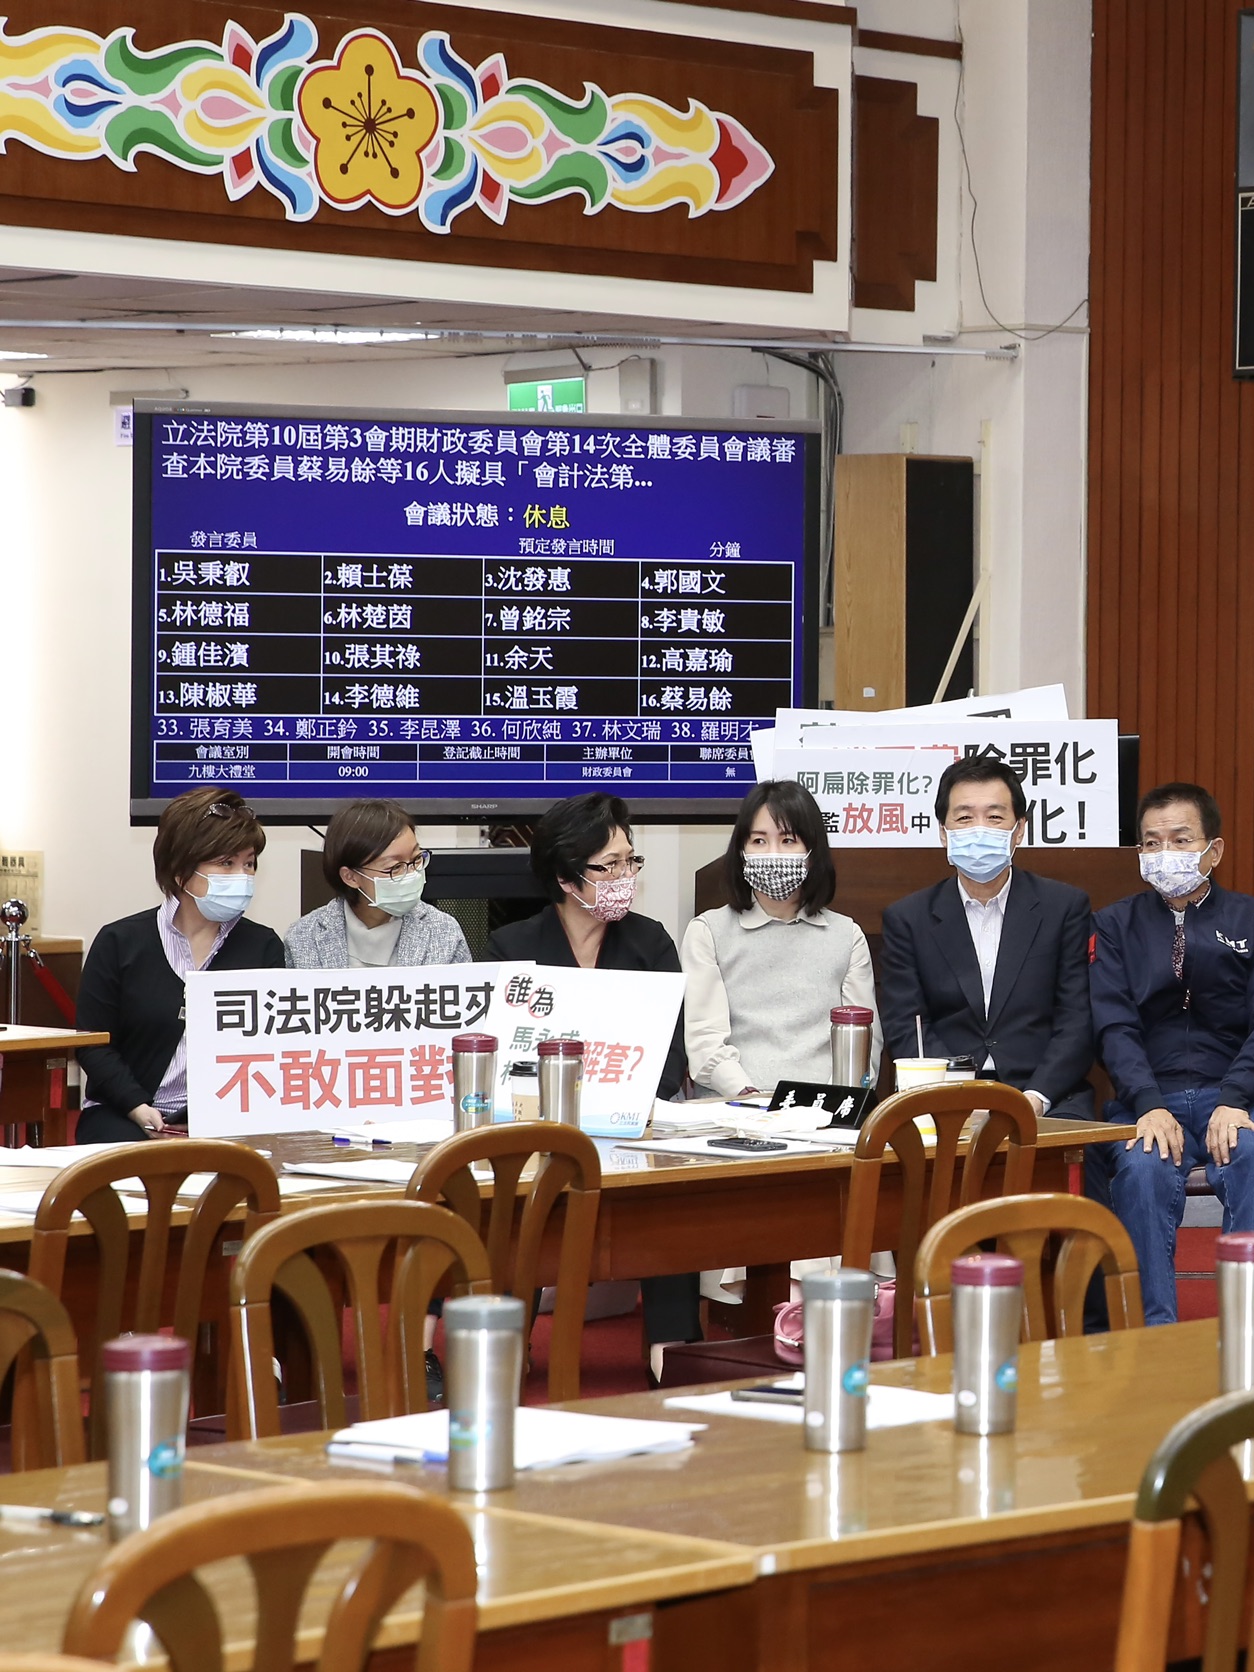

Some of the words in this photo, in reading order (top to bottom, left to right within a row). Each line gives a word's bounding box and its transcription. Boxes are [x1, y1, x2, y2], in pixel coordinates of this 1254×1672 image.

[161, 419, 796, 464] 立法院第10屆第3會期財政委員會第14次全體委員會議審
[189, 530, 258, 549] 發言委員
[518, 538, 615, 556] 預定發言時間
[709, 541, 741, 558] 分鐘
[159, 560, 251, 587] 1.吳秉叡
[324, 562, 414, 590] 2.賴士葆
[484, 565, 572, 592] 3.沈發惠
[641, 568, 726, 594] 4.郭國文
[158, 600, 250, 628] 5.林德福
[323, 602, 413, 630] 6.林楚茵
[484, 605, 571, 632] 7.曾銘宗
[640, 607, 726, 633] 8.李貴敏
[324, 643, 421, 670] 10.張其祿
[485, 644, 554, 671] 11.余天
[641, 646, 733, 673] 12.高嘉瑜
[158, 681, 258, 708] 13.陳椒華
[324, 682, 420, 709] 14.李德維
[484, 684, 579, 711] 15.溫玉霞
[641, 685, 733, 711] 16.蔡易餘
[157, 718, 184, 736] 33.
[189, 717, 253, 739] 張育美
[263, 719, 290, 736] 34.
[295, 718, 358, 740] 鄭正鈐
[368, 719, 394, 737] 35.
[399, 718, 461, 740] 李昆澤
[471, 720, 496, 737] 36.
[501, 719, 562, 741] 何欣純
[572, 721, 597, 738] 37.
[601, 719, 662, 741] 林文瑞
[671, 721, 695, 738] 38.
[195, 744, 250, 759] 會議室別
[327, 745, 380, 760] 開會時間
[443, 746, 521, 760] 登記截止時間
[582, 747, 633, 761] 主辦單位
[699, 746, 754, 761] 聯席委員
[188, 764, 256, 779] 九樓大禮堂
[338, 765, 369, 777] 09:00
[582, 766, 633, 778] 財政委員會
[725, 766, 736, 778] 無
[796, 771, 933, 796] 阿扁除罪化?
[506, 974, 555, 1017] 誰為
